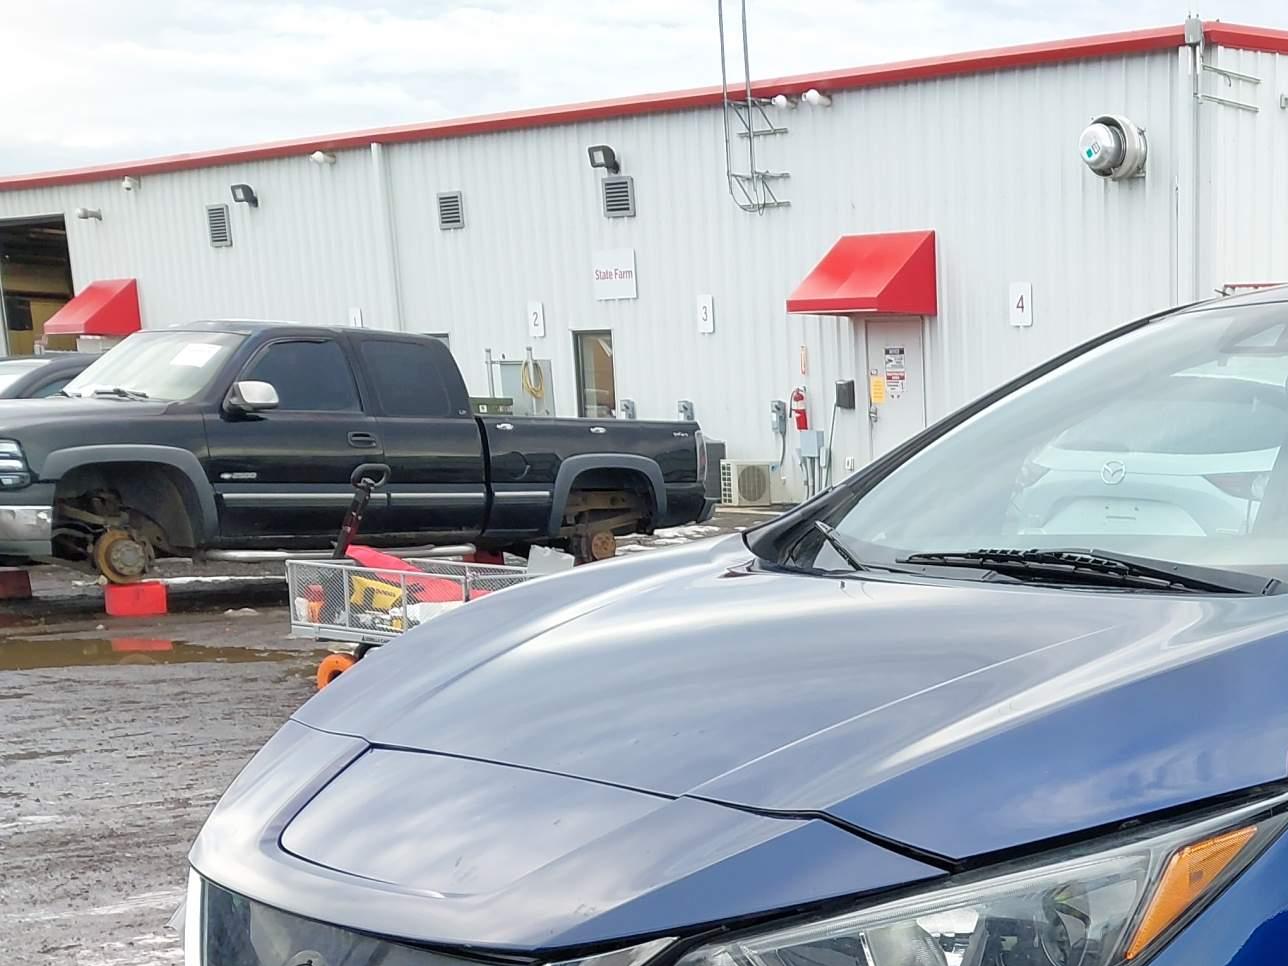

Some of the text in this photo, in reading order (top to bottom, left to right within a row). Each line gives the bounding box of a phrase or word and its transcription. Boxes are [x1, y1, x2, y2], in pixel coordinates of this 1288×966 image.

[595, 268, 633, 280] State Farm
[1016, 294, 1025, 313] 4
[532, 311, 540, 327] 2
[702, 305, 708, 322] 3
